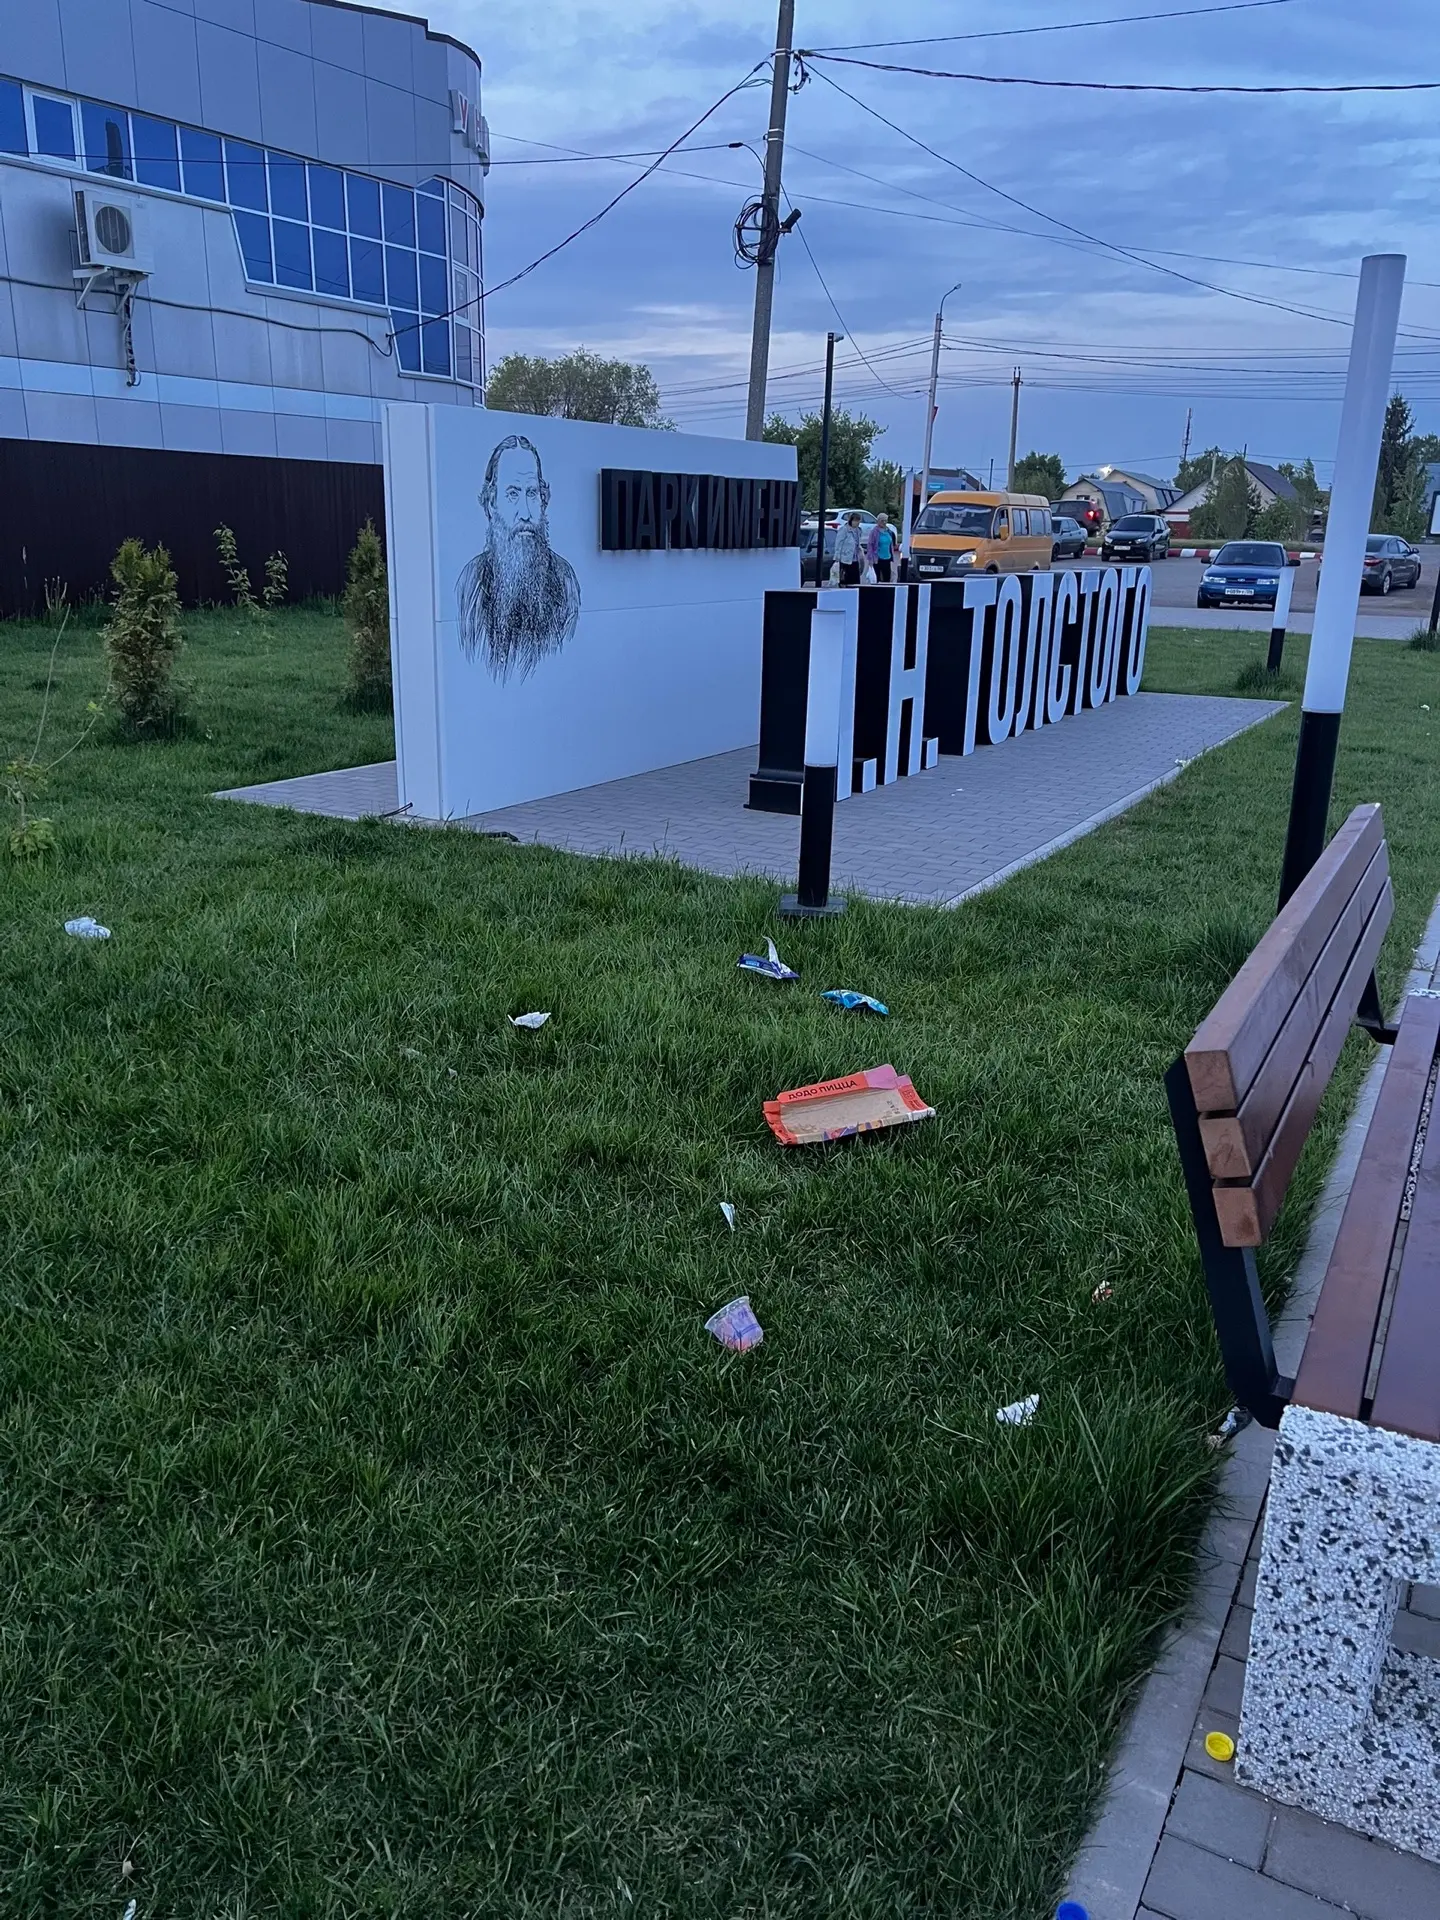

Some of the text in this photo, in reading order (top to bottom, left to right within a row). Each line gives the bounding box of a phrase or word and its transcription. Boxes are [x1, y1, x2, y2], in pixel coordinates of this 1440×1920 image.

[603, 468, 801, 550] ПАРК ИМЕНИ
[948, 565, 1152, 758] ТОЛСТОГО
[788, 1080, 857, 1100] ДОДО ПИЦЦА
